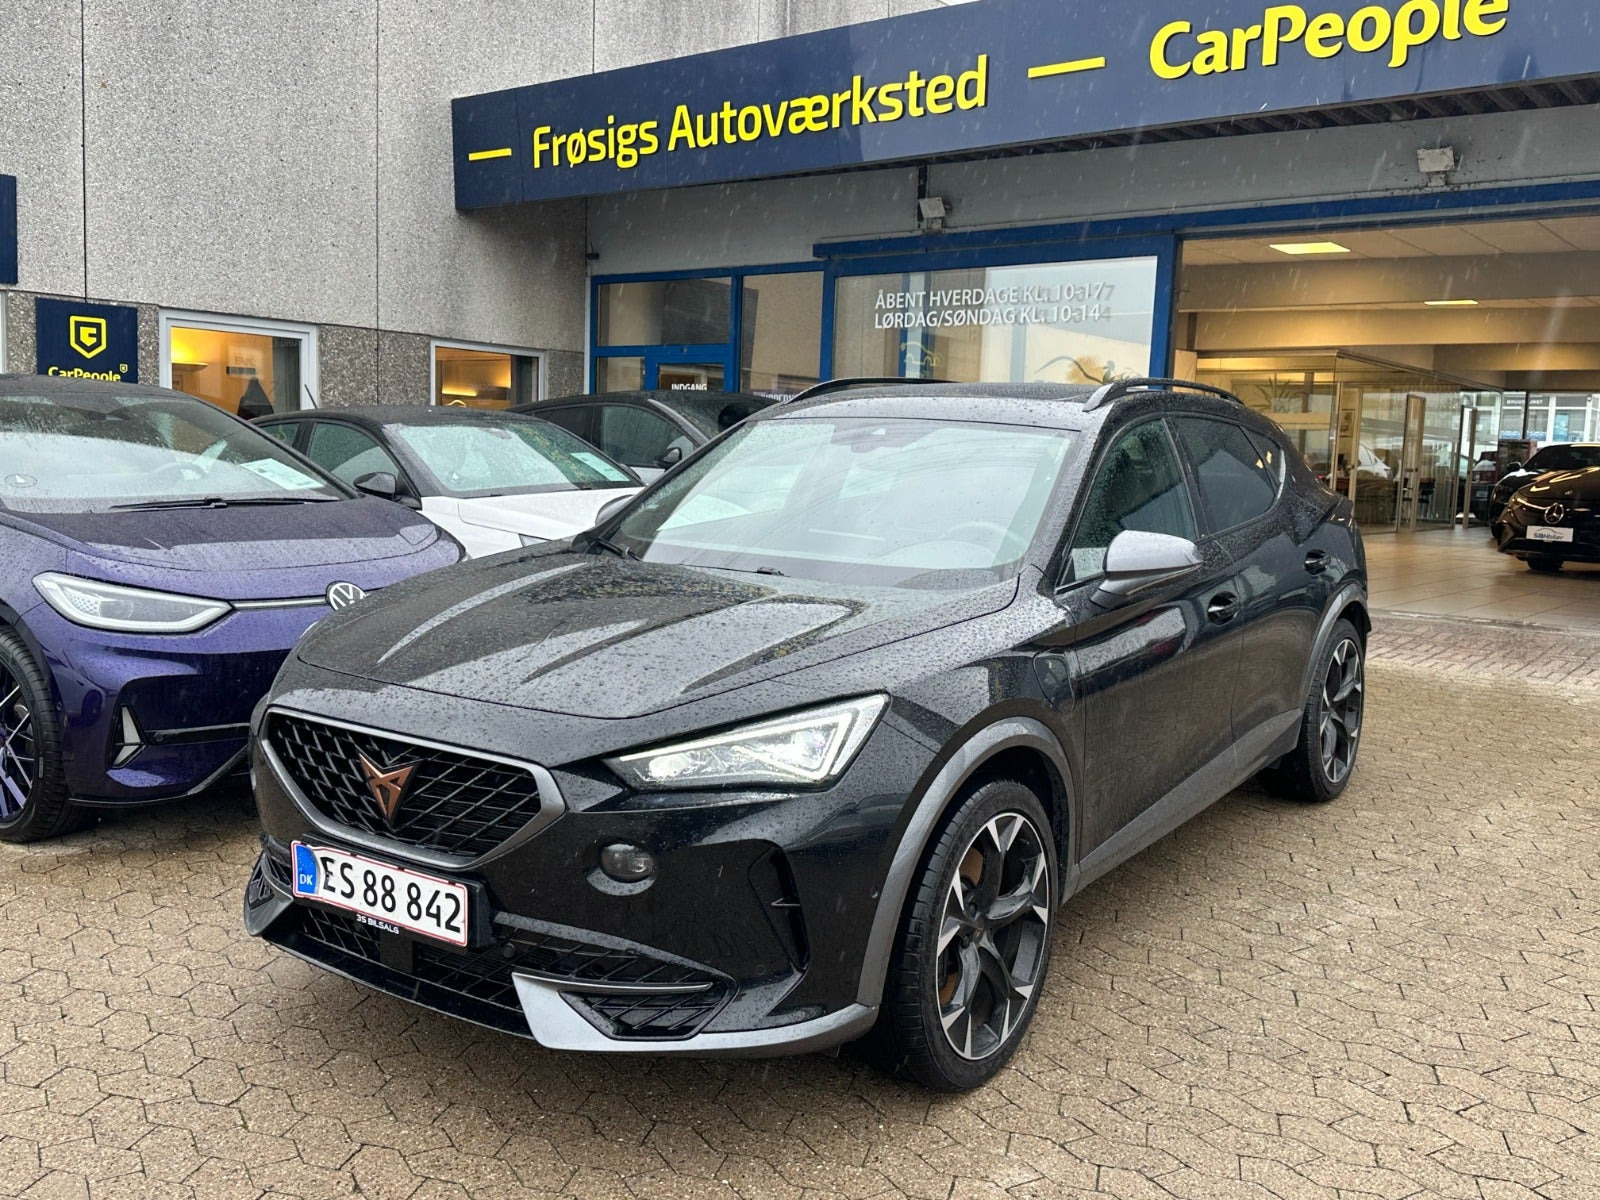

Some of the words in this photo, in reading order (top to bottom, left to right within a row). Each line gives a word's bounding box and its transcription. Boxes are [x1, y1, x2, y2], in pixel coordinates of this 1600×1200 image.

[533, 120, 659, 169] Frøsigs
[667, 55, 988, 152] Autoværksted
[1150, 0, 1509, 78] CarPeople
[874, 289, 927, 309] ÅBENT
[929, 286, 1019, 307] HVERDAGE
[1056, 281, 1104, 301] 10-17
[874, 308, 1015, 329] LØRDAG/SØNDAG
[1051, 303, 1101, 322] 10-14
[299, 873, 314, 886] DK
[320, 856, 355, 899] ES
[363, 869, 396, 913] 88
[406, 882, 461, 934] 842
